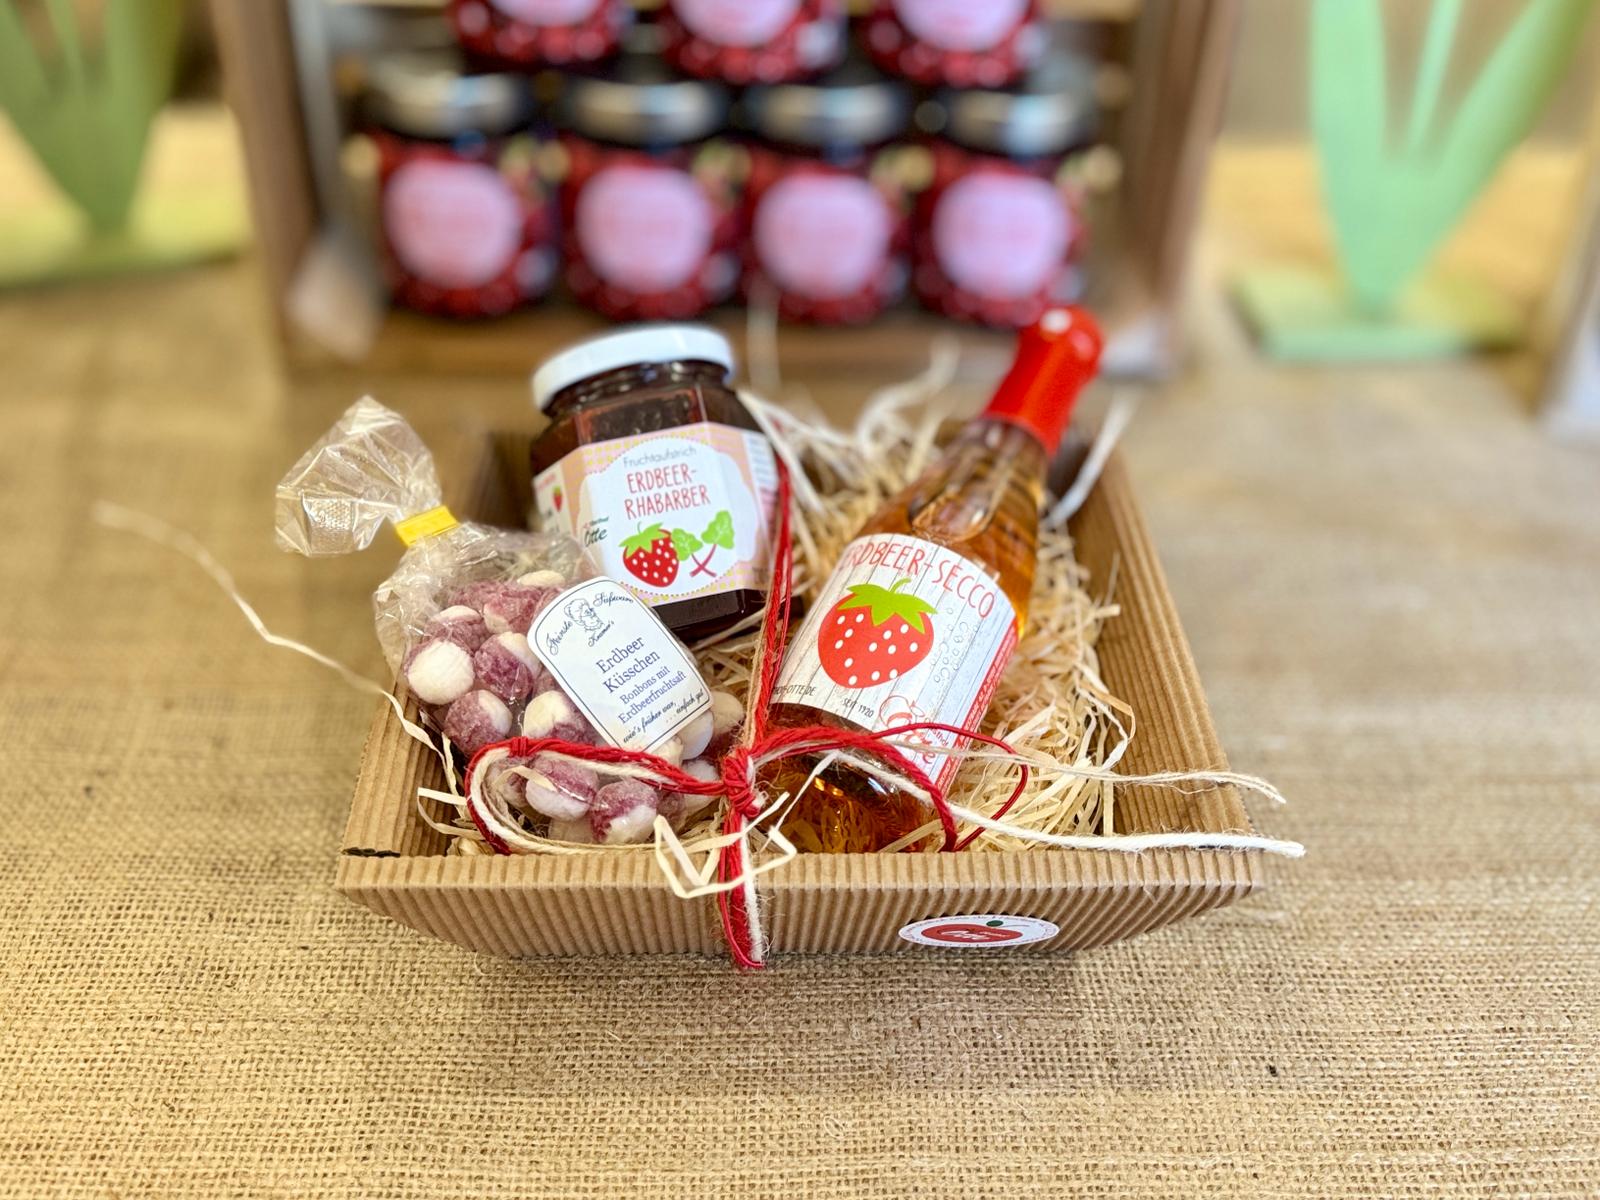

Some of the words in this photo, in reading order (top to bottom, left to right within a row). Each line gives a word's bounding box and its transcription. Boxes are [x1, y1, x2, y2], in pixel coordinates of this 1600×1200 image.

[627, 463, 698, 494] ERDBEER-
[624, 484, 711, 520] RHABARBER
[596, 636, 645, 674] Erdbeer
[602, 651, 661, 694] Küsschen
[618, 670, 687, 724] Erdbeerfruchtsaft
[620, 675, 657, 705] Bonbons
[656, 665, 671, 680] mit
